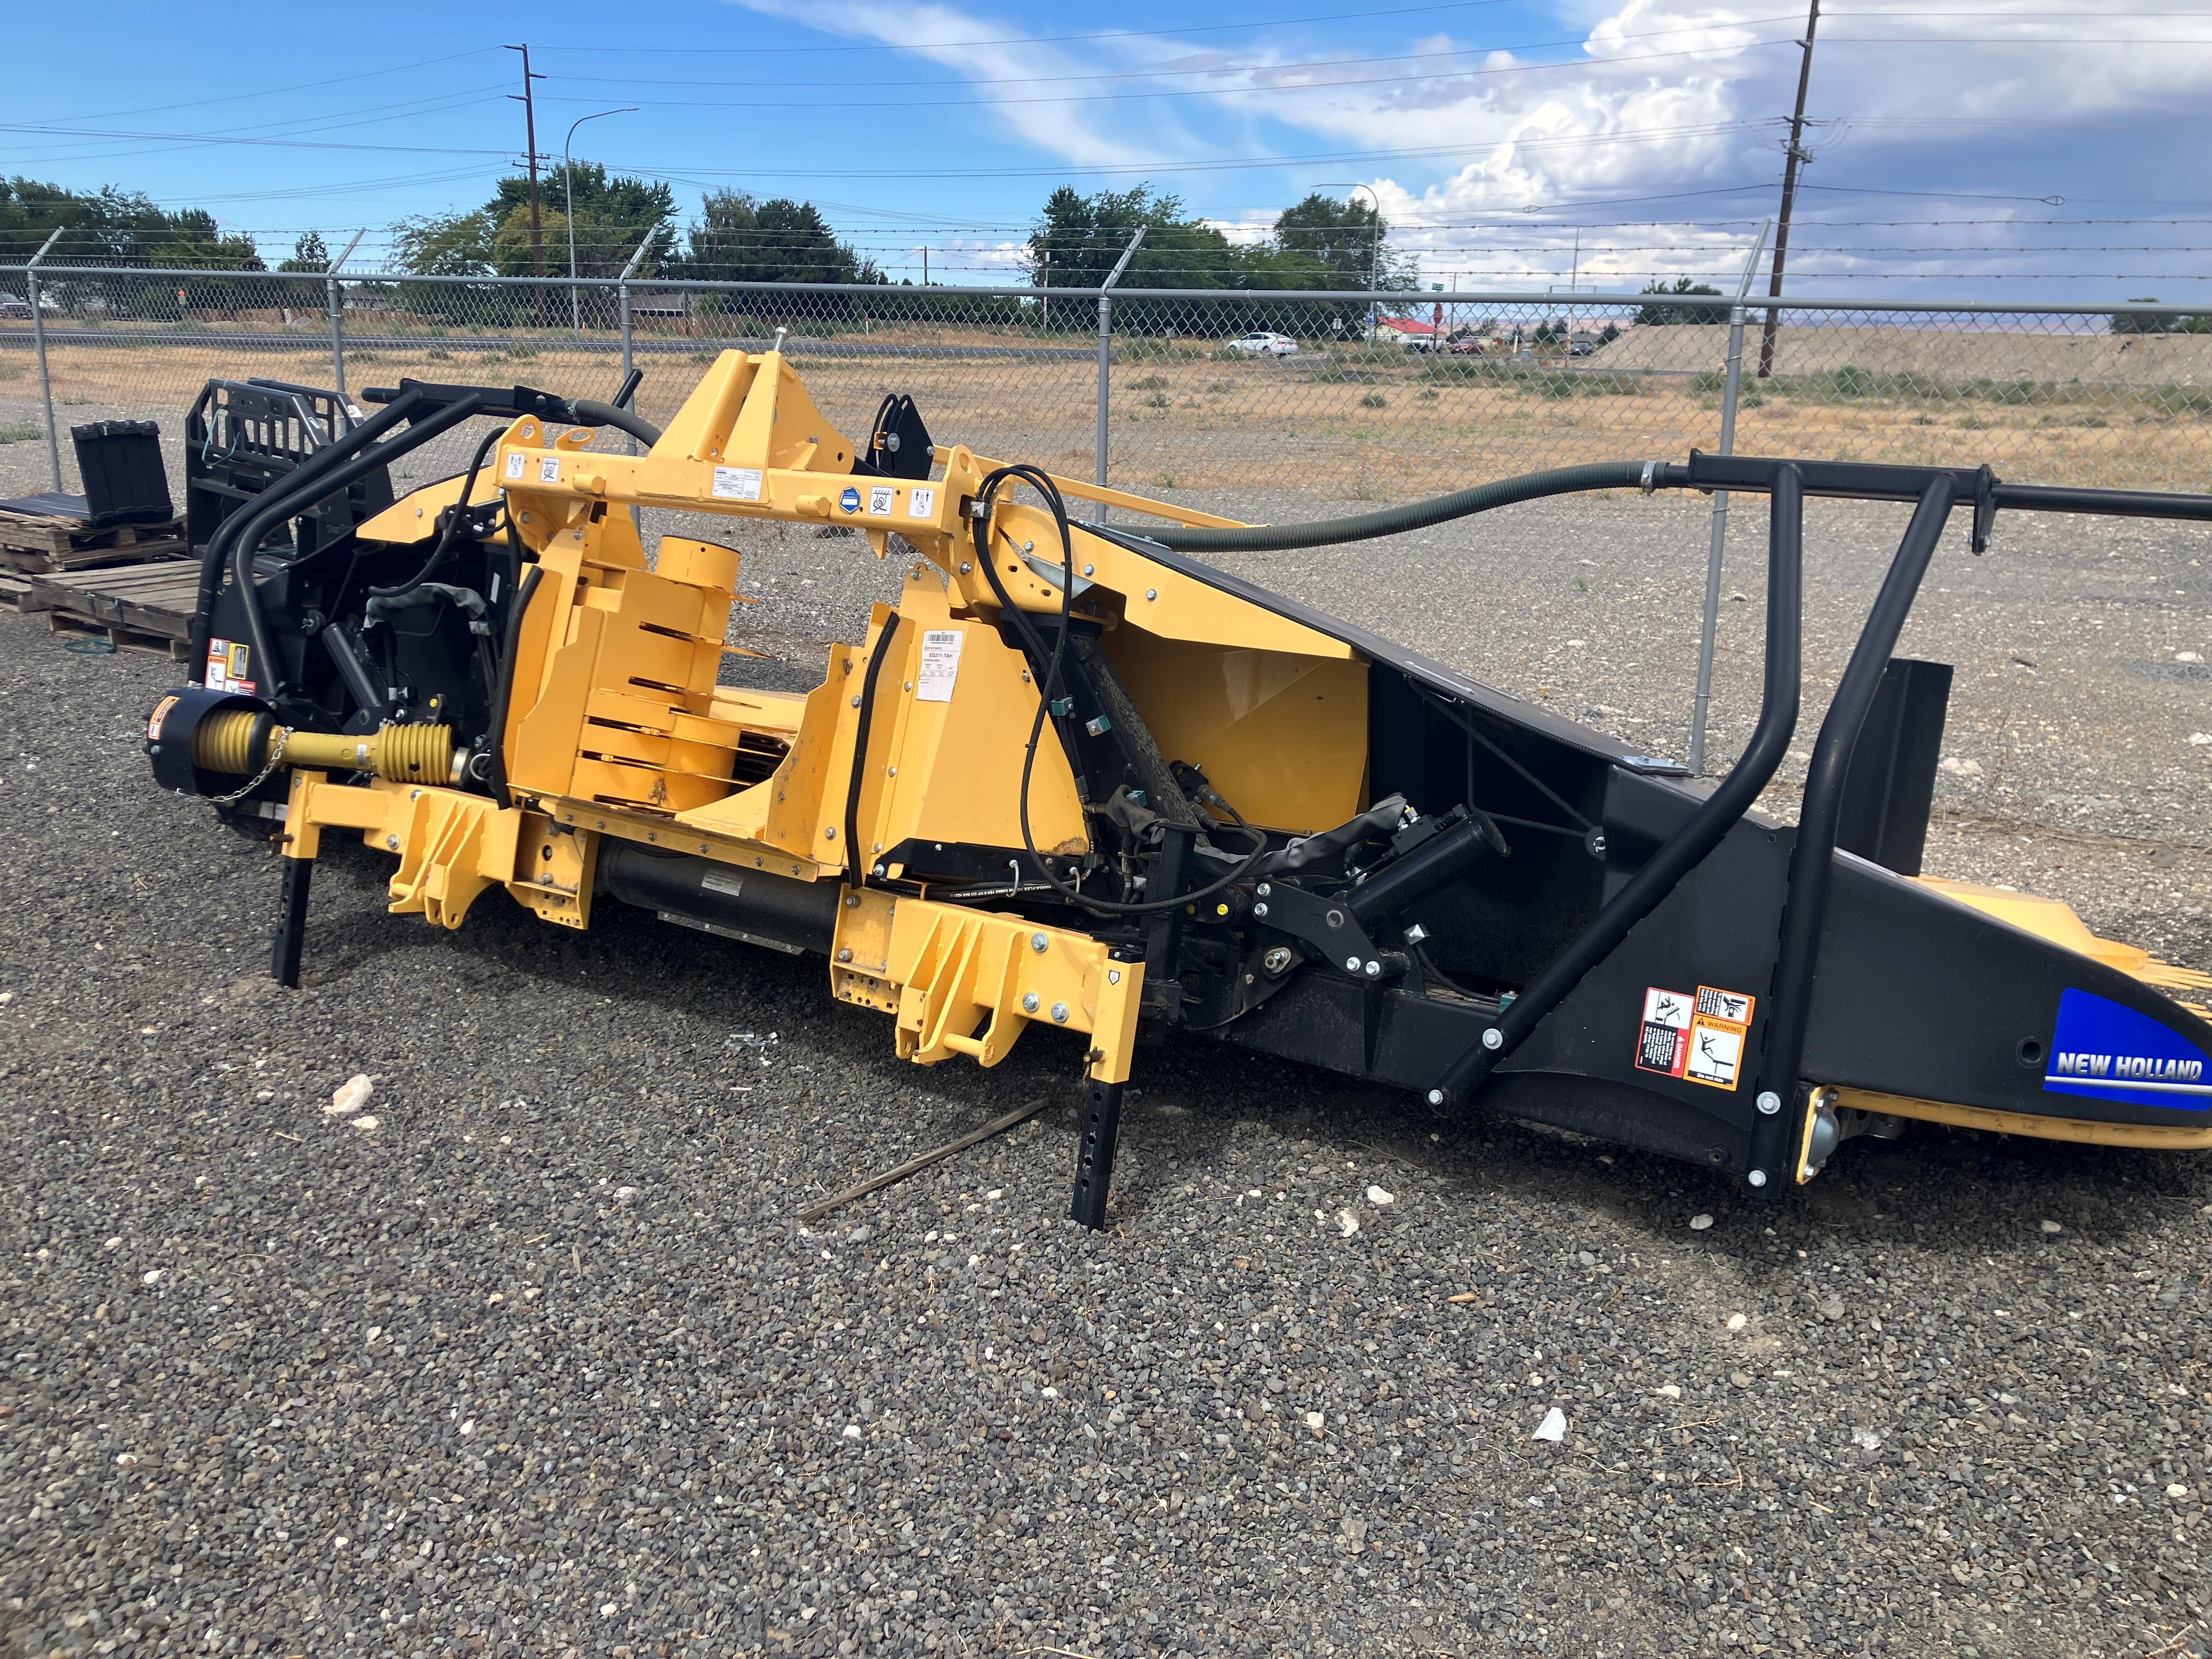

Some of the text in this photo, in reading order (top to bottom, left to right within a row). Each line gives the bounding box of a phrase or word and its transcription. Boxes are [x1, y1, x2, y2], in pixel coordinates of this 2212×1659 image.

[1707, 1020, 1742, 1034] WARNING
[1673, 1043, 1683, 1069] DANGER
[2056, 1052, 2203, 1082] NEW HOLLAND
